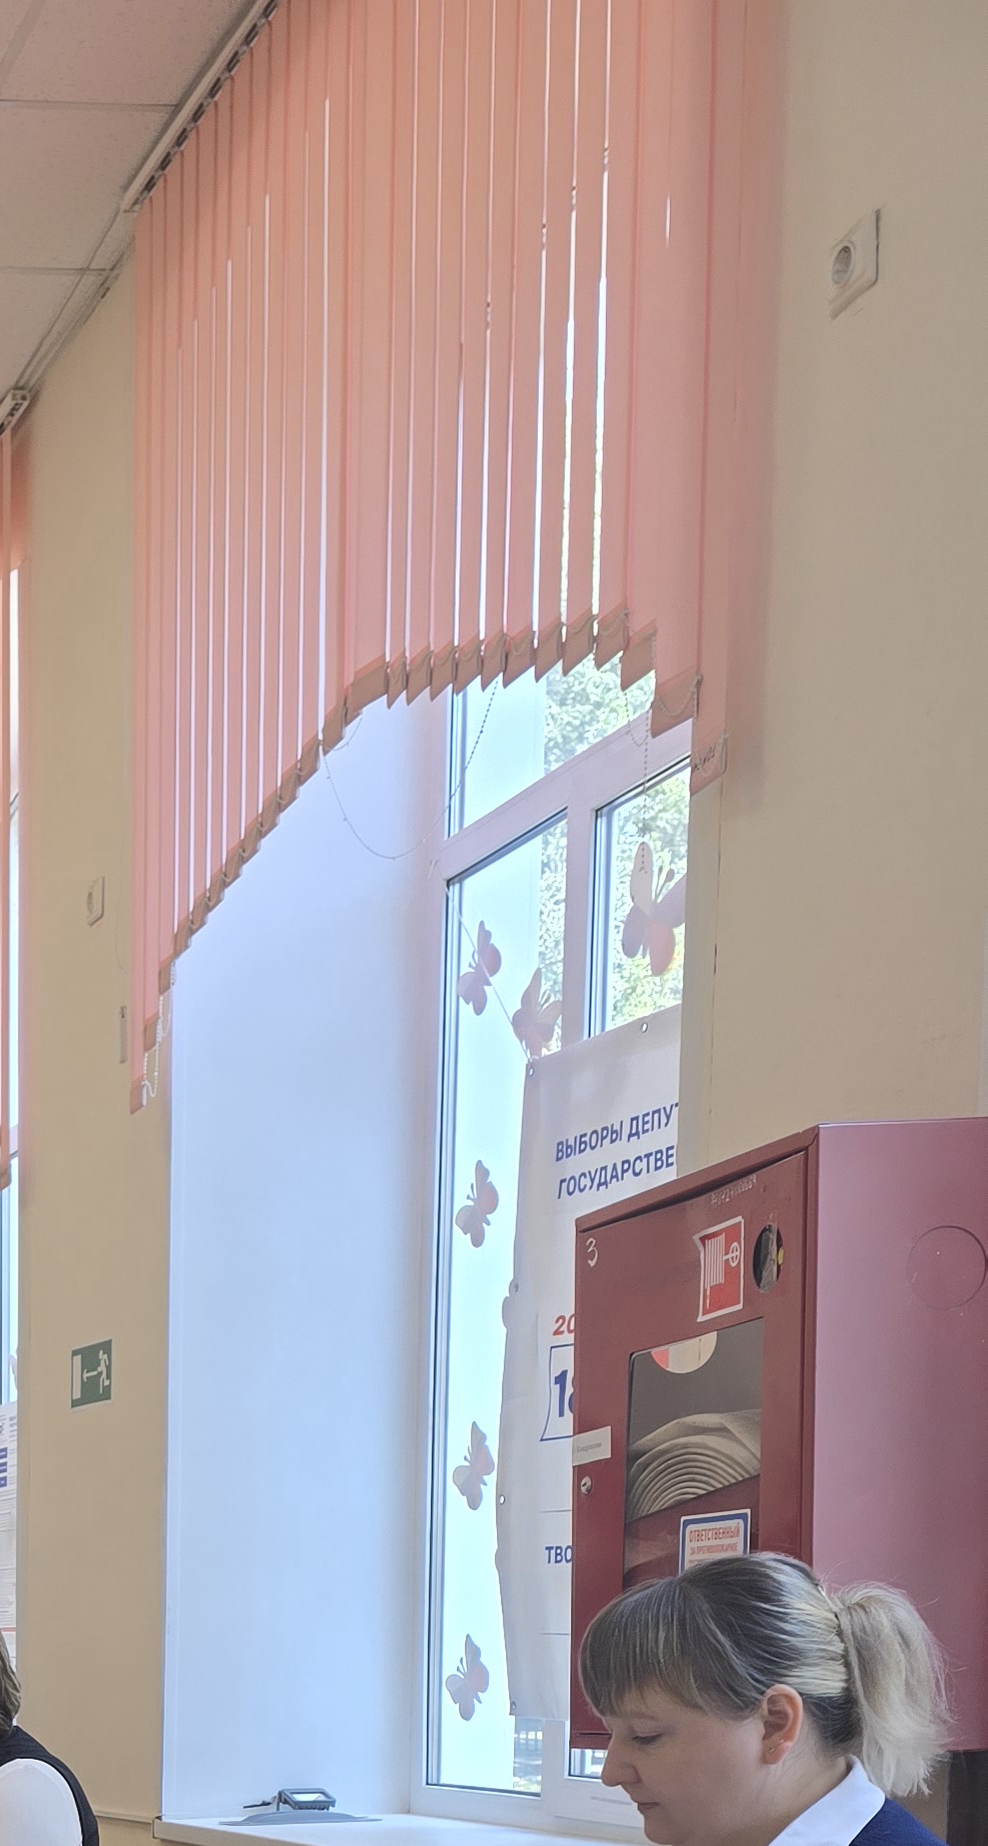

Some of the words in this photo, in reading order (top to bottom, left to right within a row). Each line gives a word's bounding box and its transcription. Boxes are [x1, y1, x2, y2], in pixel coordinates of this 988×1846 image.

[555, 1120, 624, 1162] ВЫБОРЫ
[627, 1102, 679, 1142] ДЕПУ
[586, 1237, 598, 1267] 3
